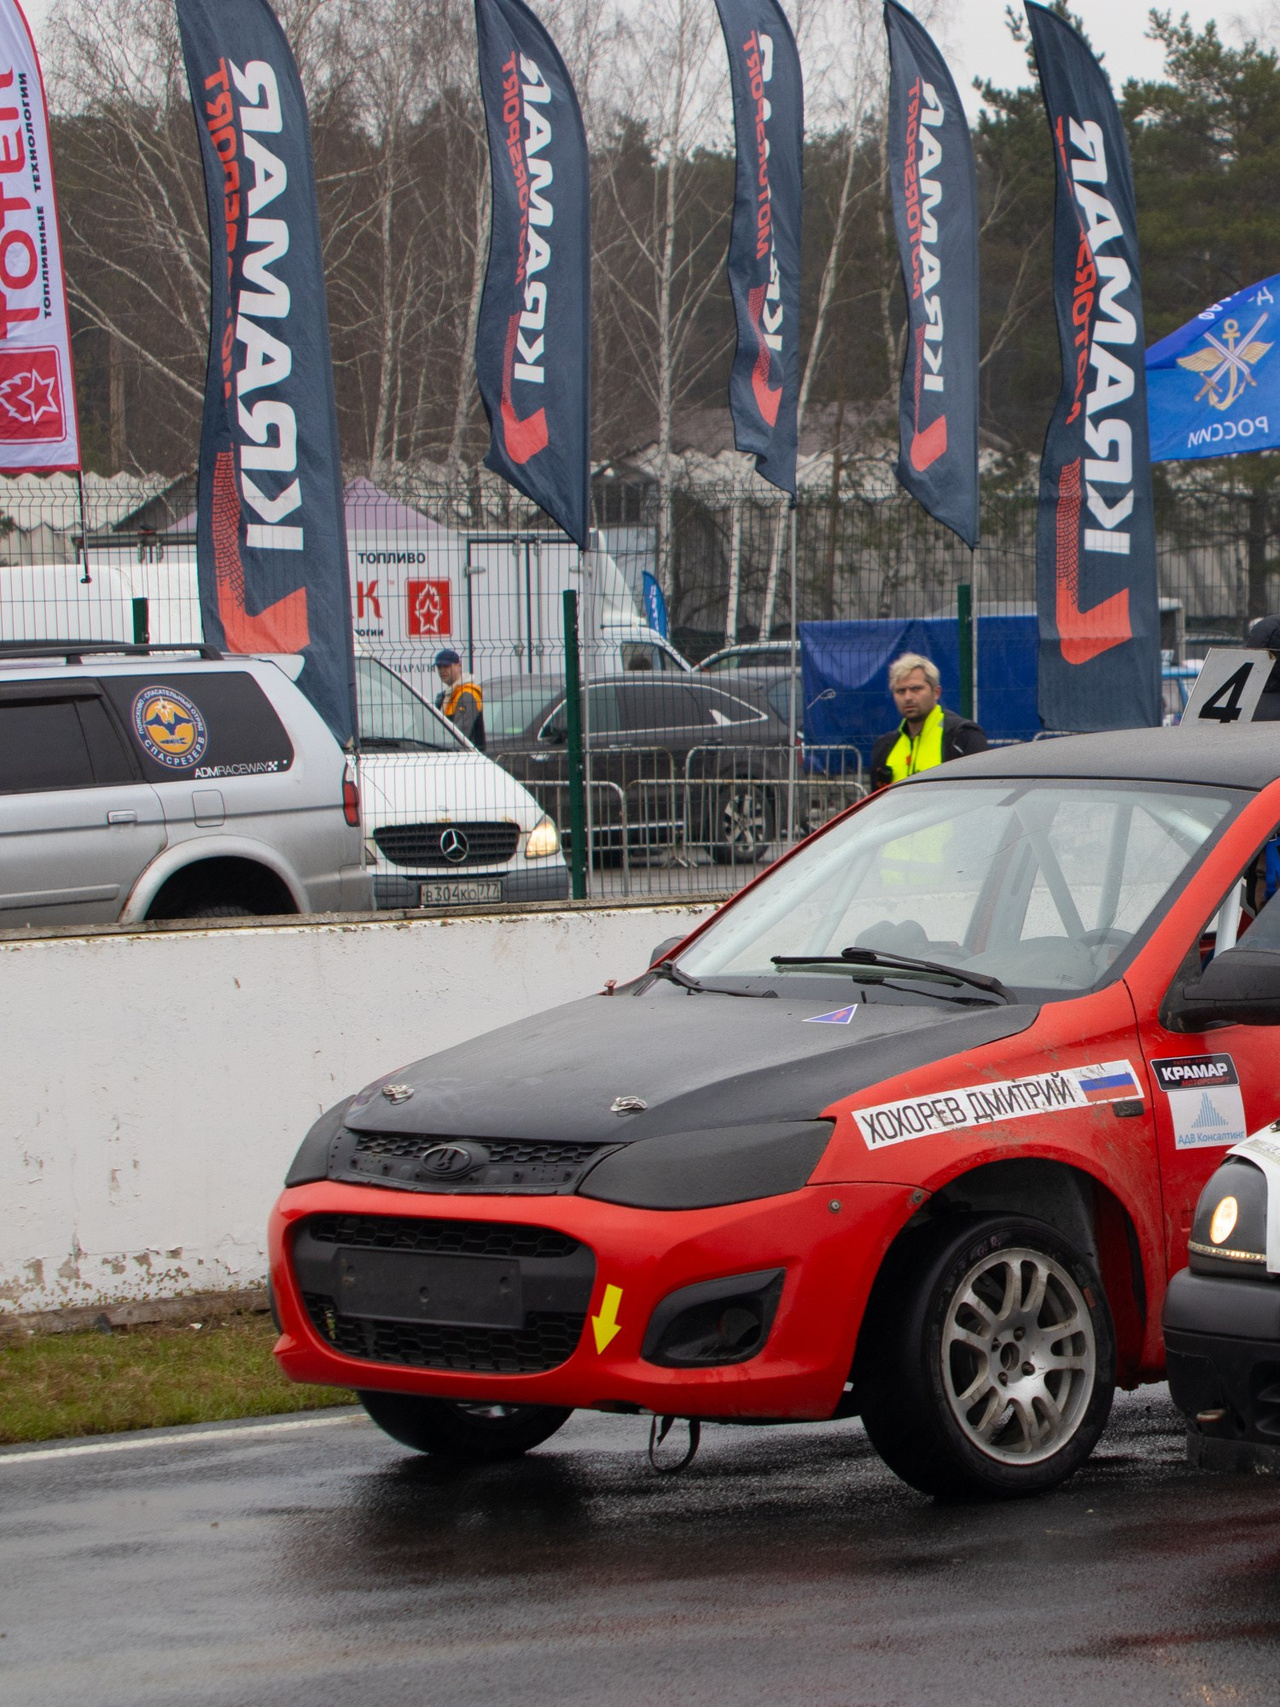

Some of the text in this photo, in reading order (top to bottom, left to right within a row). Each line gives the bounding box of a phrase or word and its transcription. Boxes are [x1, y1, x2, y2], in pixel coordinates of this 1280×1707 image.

[18, 72, 52, 320] ТОПЛИВНЫЕ ТЕХНОЛОГИИ
[358, 552, 426, 564] ТОПЛИВО
[1198, 661, 1255, 724] 4
[144, 736, 206, 766] СПАСРЕЗЕРВ
[1161, 1062, 1228, 1081] КРАМАР
[861, 1072, 1077, 1144] ХОХОРЕВ ДМИТРИЙ
[1197, 1131, 1246, 1144] Консалтинг
